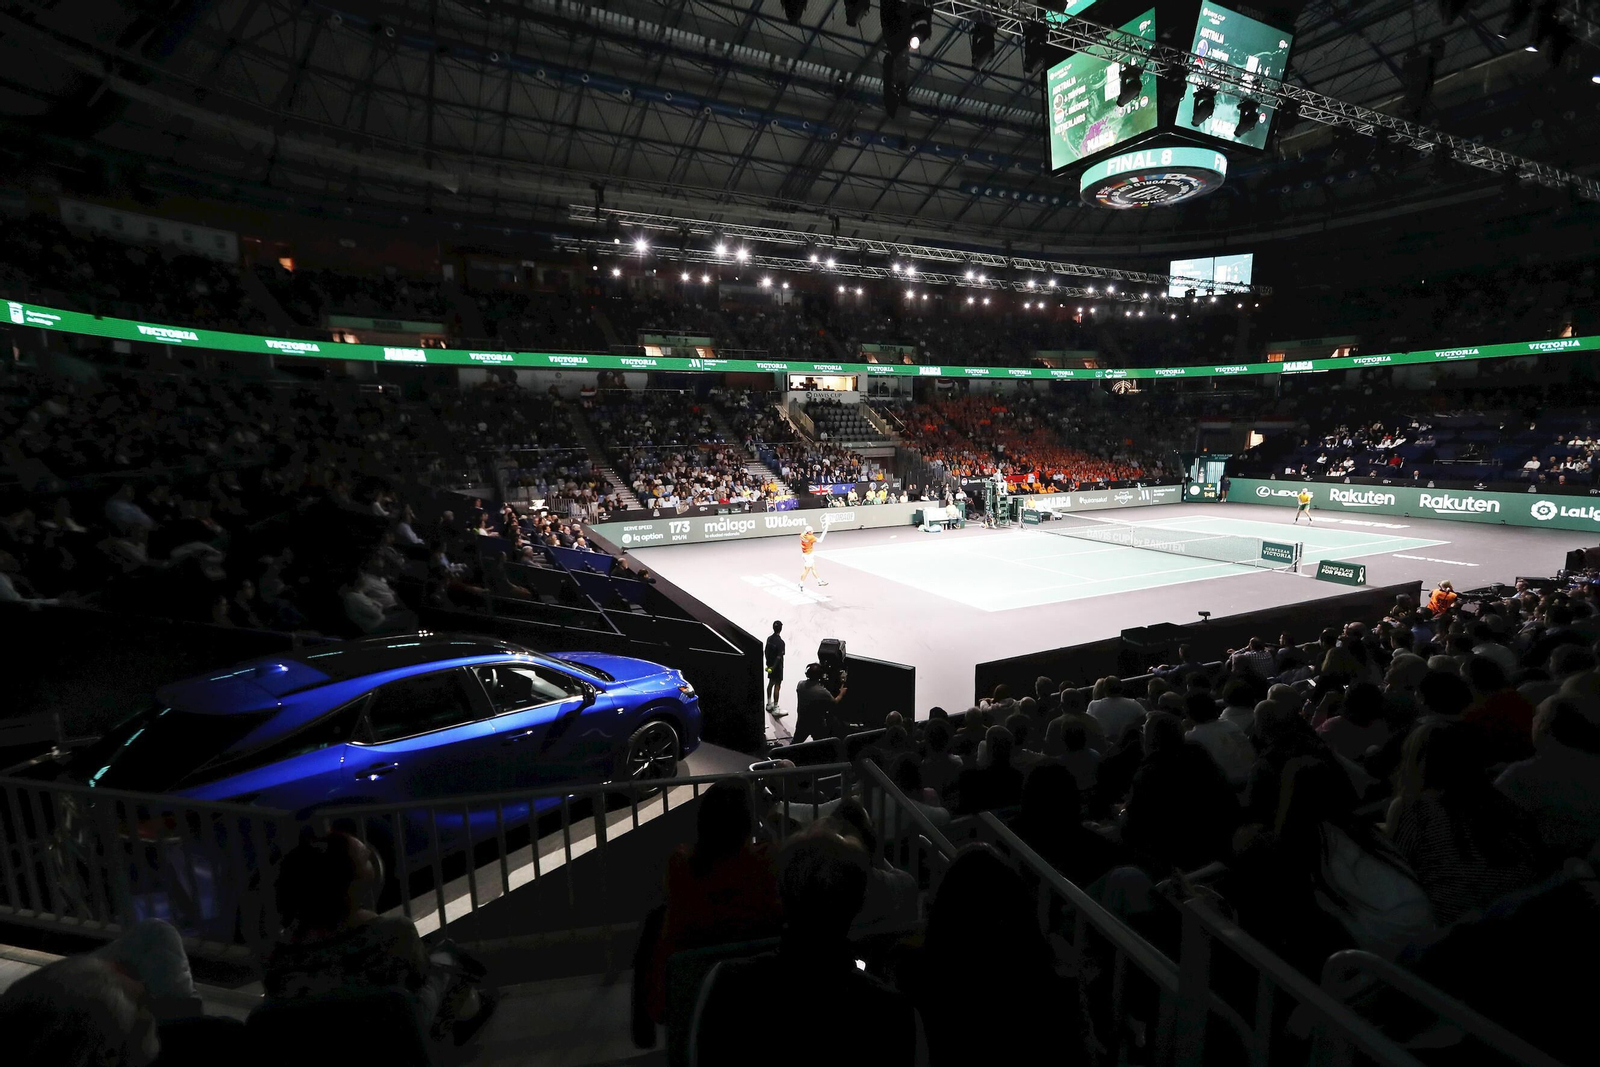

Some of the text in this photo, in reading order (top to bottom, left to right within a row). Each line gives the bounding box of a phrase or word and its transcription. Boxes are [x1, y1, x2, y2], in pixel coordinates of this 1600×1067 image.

[1106, 149, 1172, 176] FINAL 8
[137, 326, 199, 340] VICTORIA
[265, 340, 320, 352] VICTORIA
[1528, 340, 1580, 350] VICTORIA
[469, 353, 514, 362] VICTORIA
[1435, 348, 1480, 358] VICTORIA
[548, 356, 588, 364] VICTORIA
[1353, 356, 1391, 364] VICTORIA
[919, 366, 942, 376] MARCA
[1283, 361, 1313, 372] MARCA
[1271, 489, 1314, 498] LEXS
[1330, 488, 1395, 505] Rakuten
[1420, 494, 1500, 512] Rakuten
[1561, 506, 1600, 522] LaLig
[764, 515, 808, 528] Wilson
[669, 521, 690, 534] 173
[641, 532, 664, 541] option
[1087, 529, 1112, 540] DAVIS
[1113, 533, 1130, 544] CUP
[1144, 538, 1186, 552] RAKUTEN
[1263, 550, 1291, 559] VICTORIA
[1334, 570, 1354, 578] PEACE
